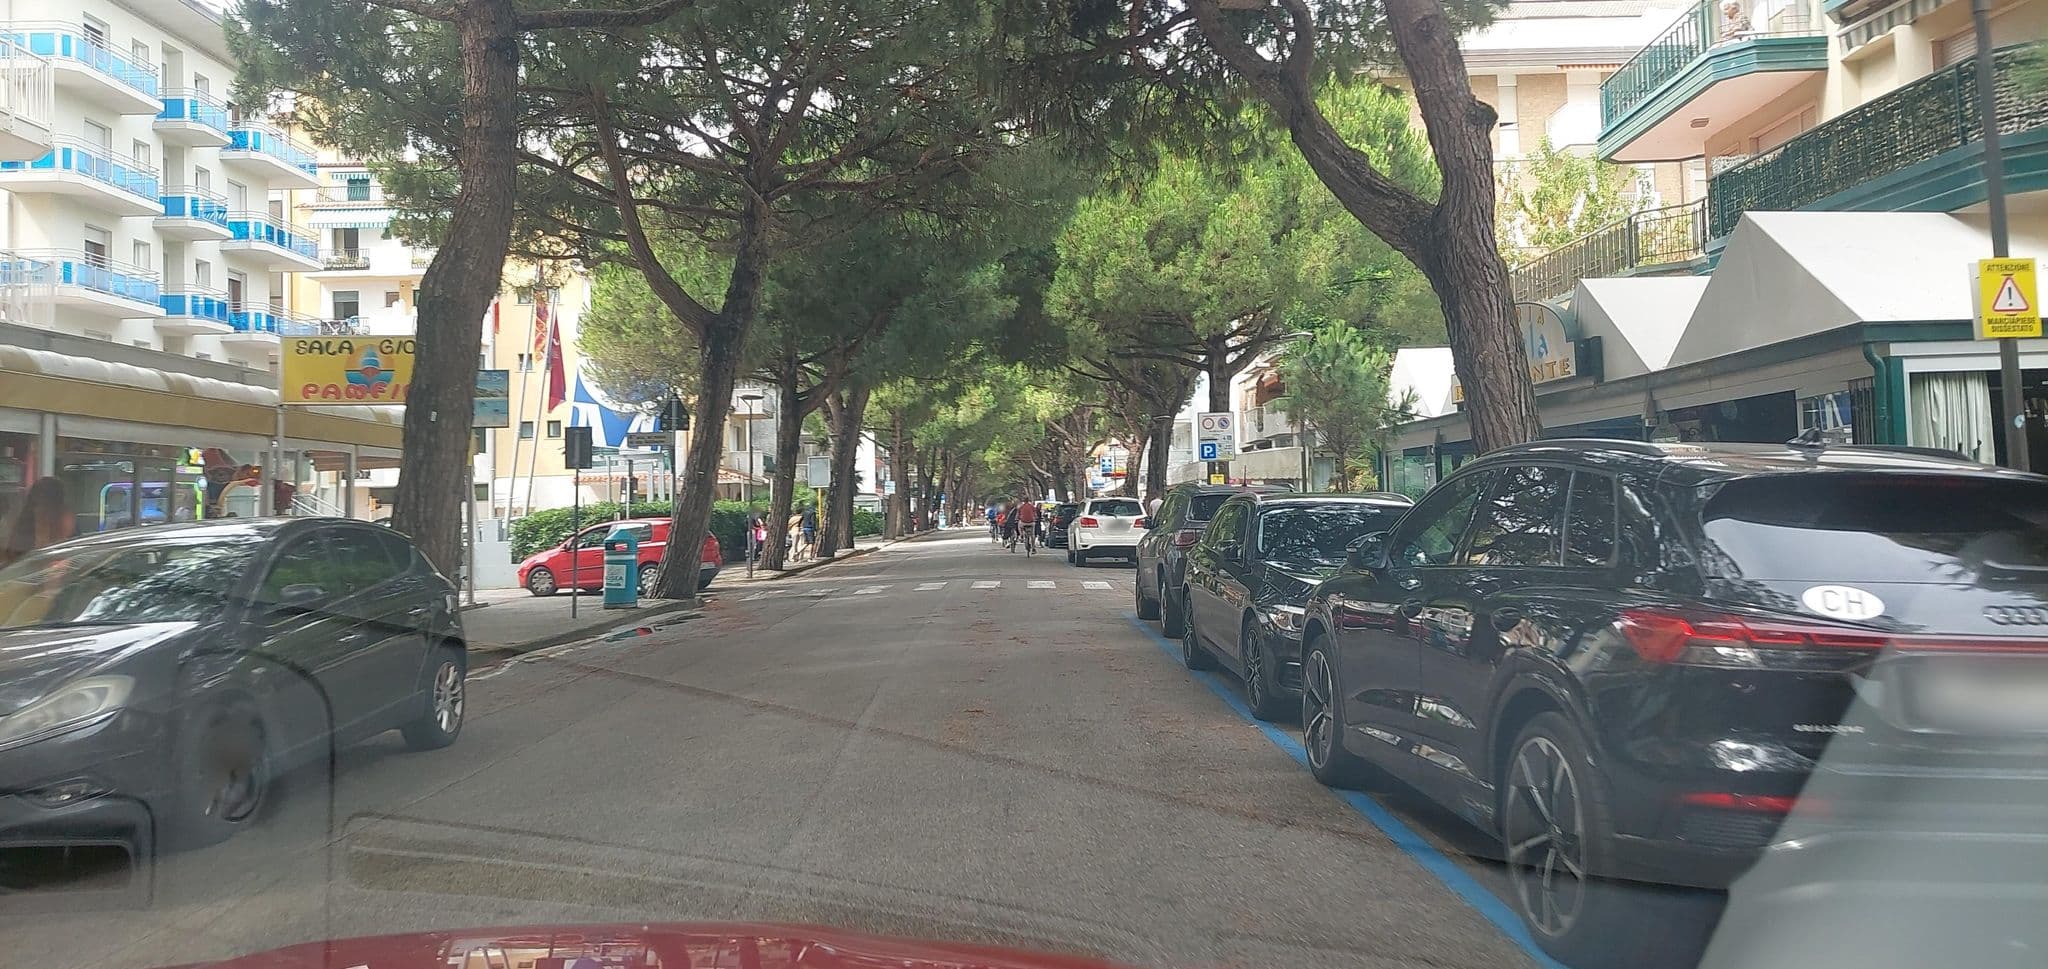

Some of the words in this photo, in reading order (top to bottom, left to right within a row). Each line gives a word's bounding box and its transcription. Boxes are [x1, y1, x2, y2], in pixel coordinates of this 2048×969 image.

[1986, 263, 2030, 272] ATTENZIONE
[1987, 317, 2036, 325] MARCIAPIEDE
[1991, 325, 2034, 333] DISSESTATO
[295, 339, 354, 356] SALA
[301, 382, 411, 400] PANFI
[1203, 445, 1214, 457] P
[1822, 590, 1867, 616] CH
